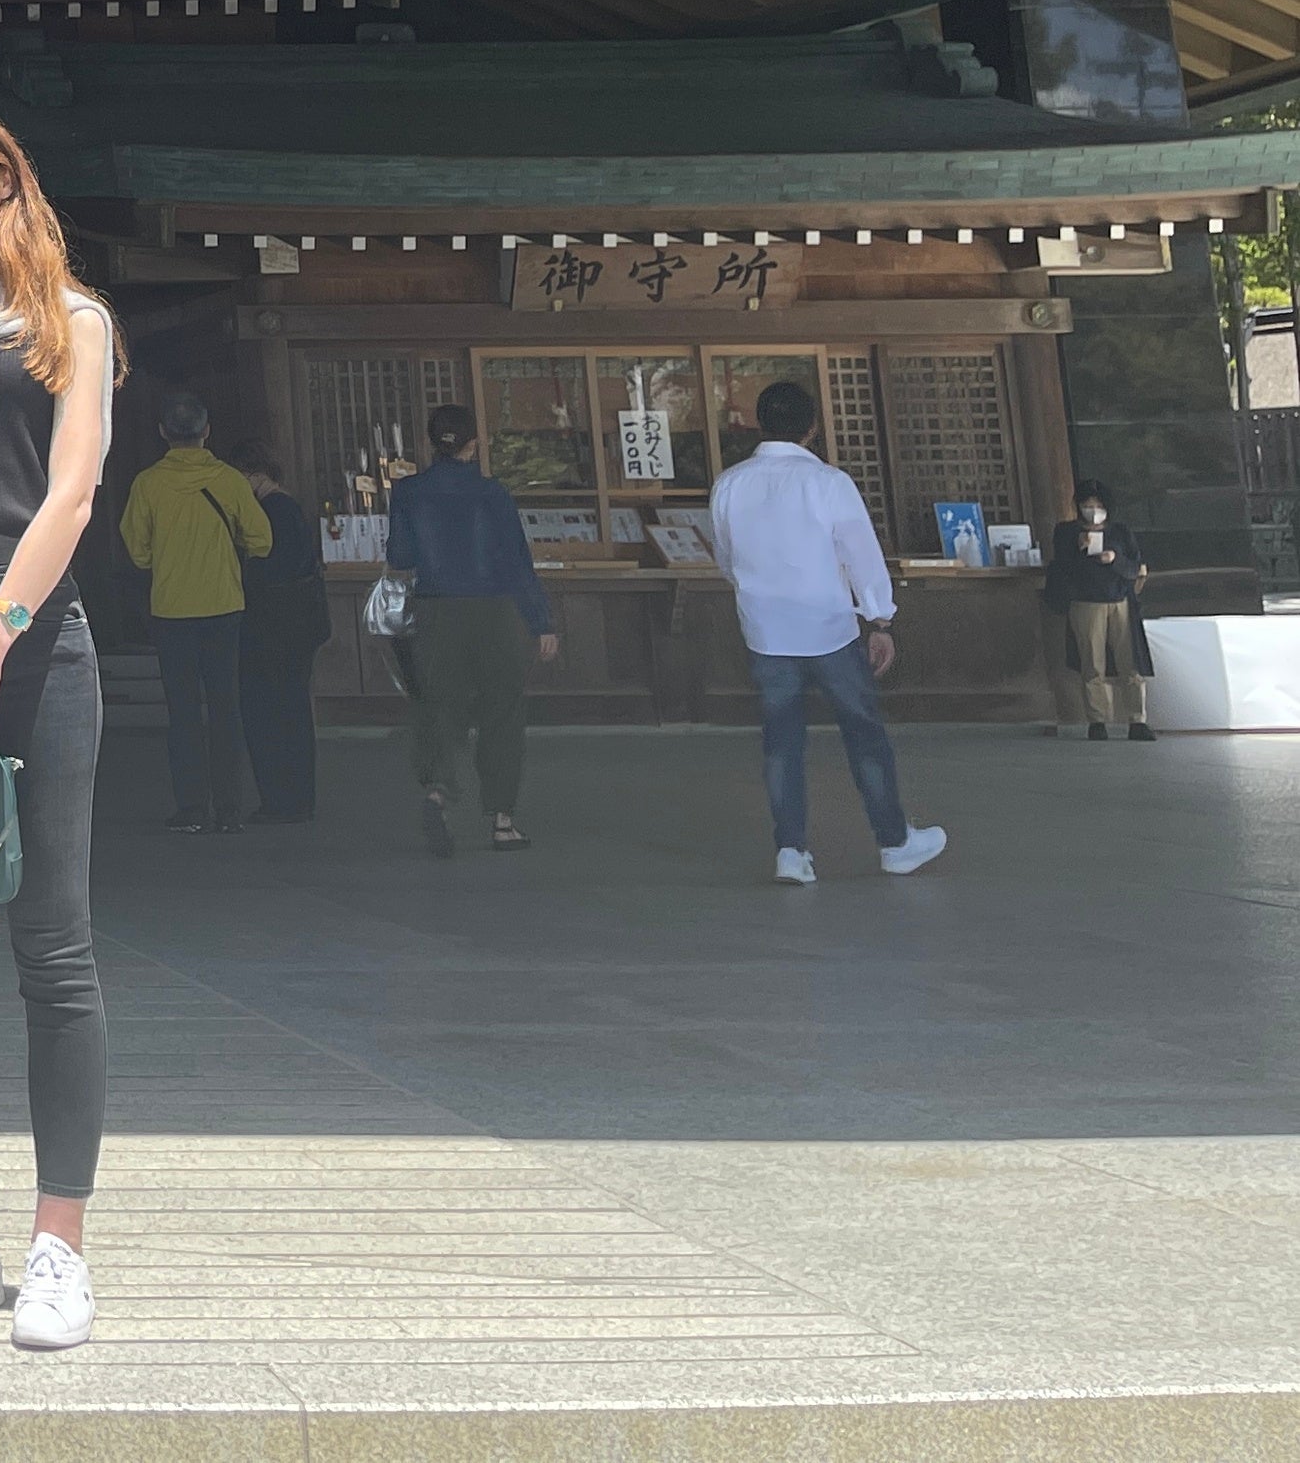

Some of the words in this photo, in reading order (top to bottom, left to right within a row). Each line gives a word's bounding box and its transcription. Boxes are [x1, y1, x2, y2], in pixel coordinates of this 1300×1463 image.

[538, 247, 778, 304] 御守所
[641, 413, 665, 478] おみくじ
